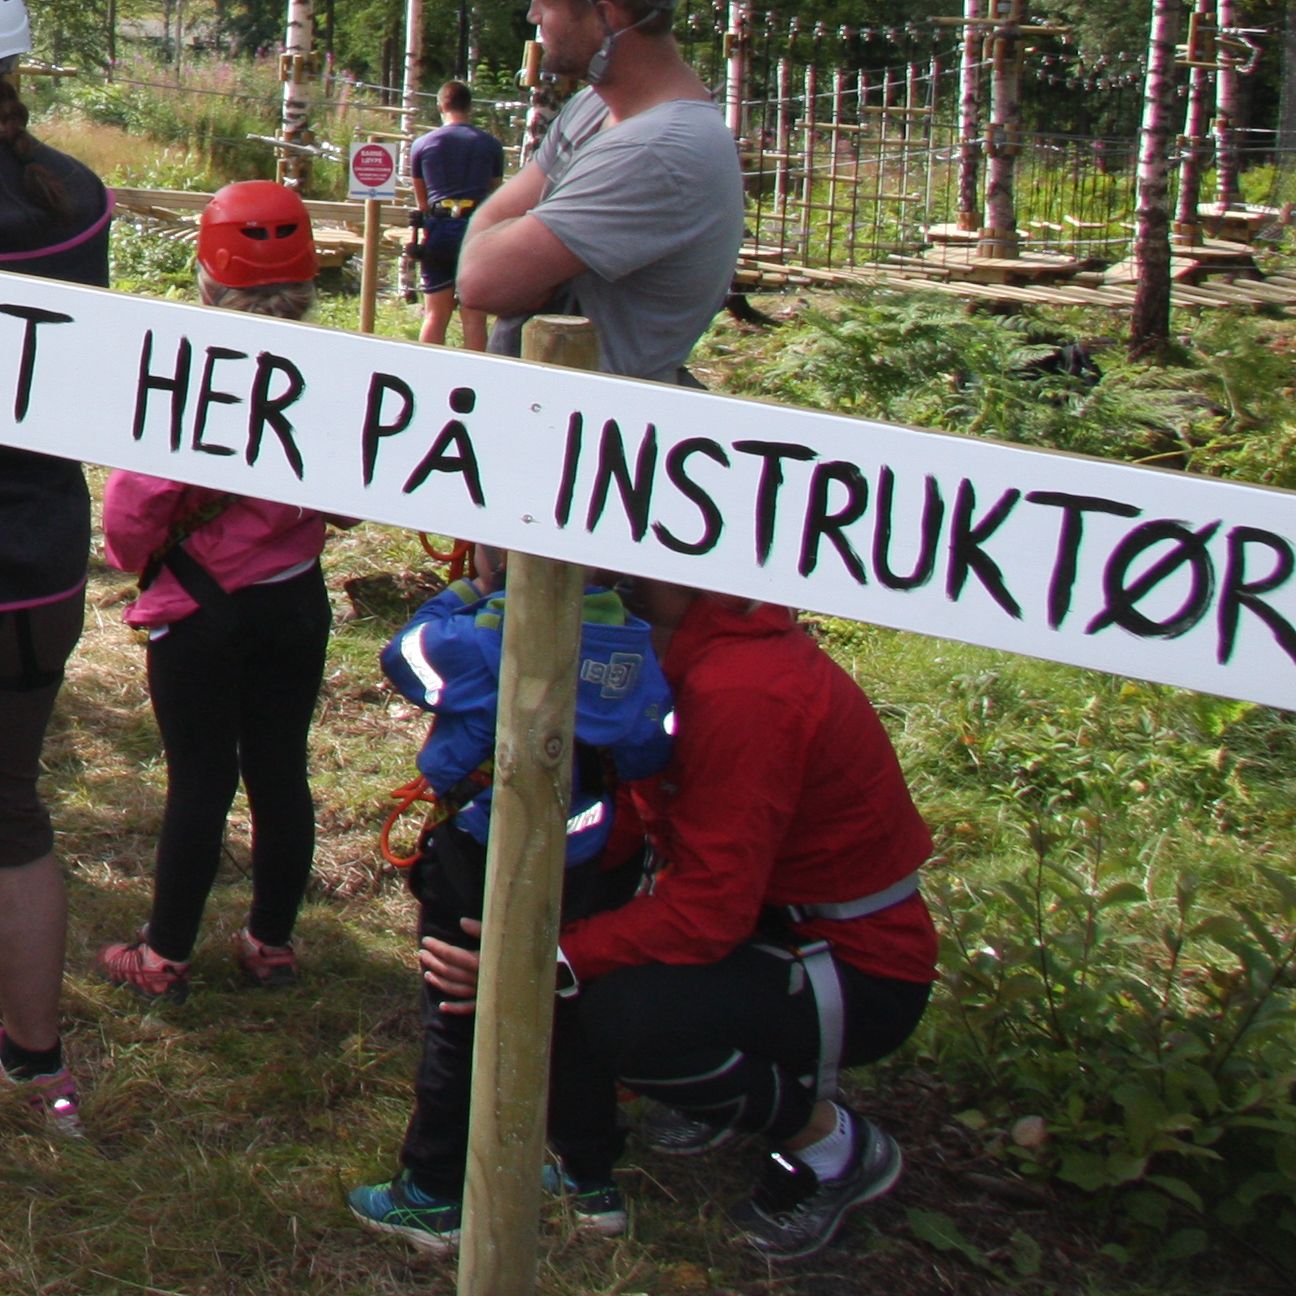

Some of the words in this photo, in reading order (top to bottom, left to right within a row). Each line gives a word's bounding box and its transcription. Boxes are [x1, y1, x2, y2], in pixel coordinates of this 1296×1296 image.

[132, 329, 307, 481] HER
[362, 371, 486, 507] PÅ
[554, 410, 1296, 666] INSTRUKTØR
